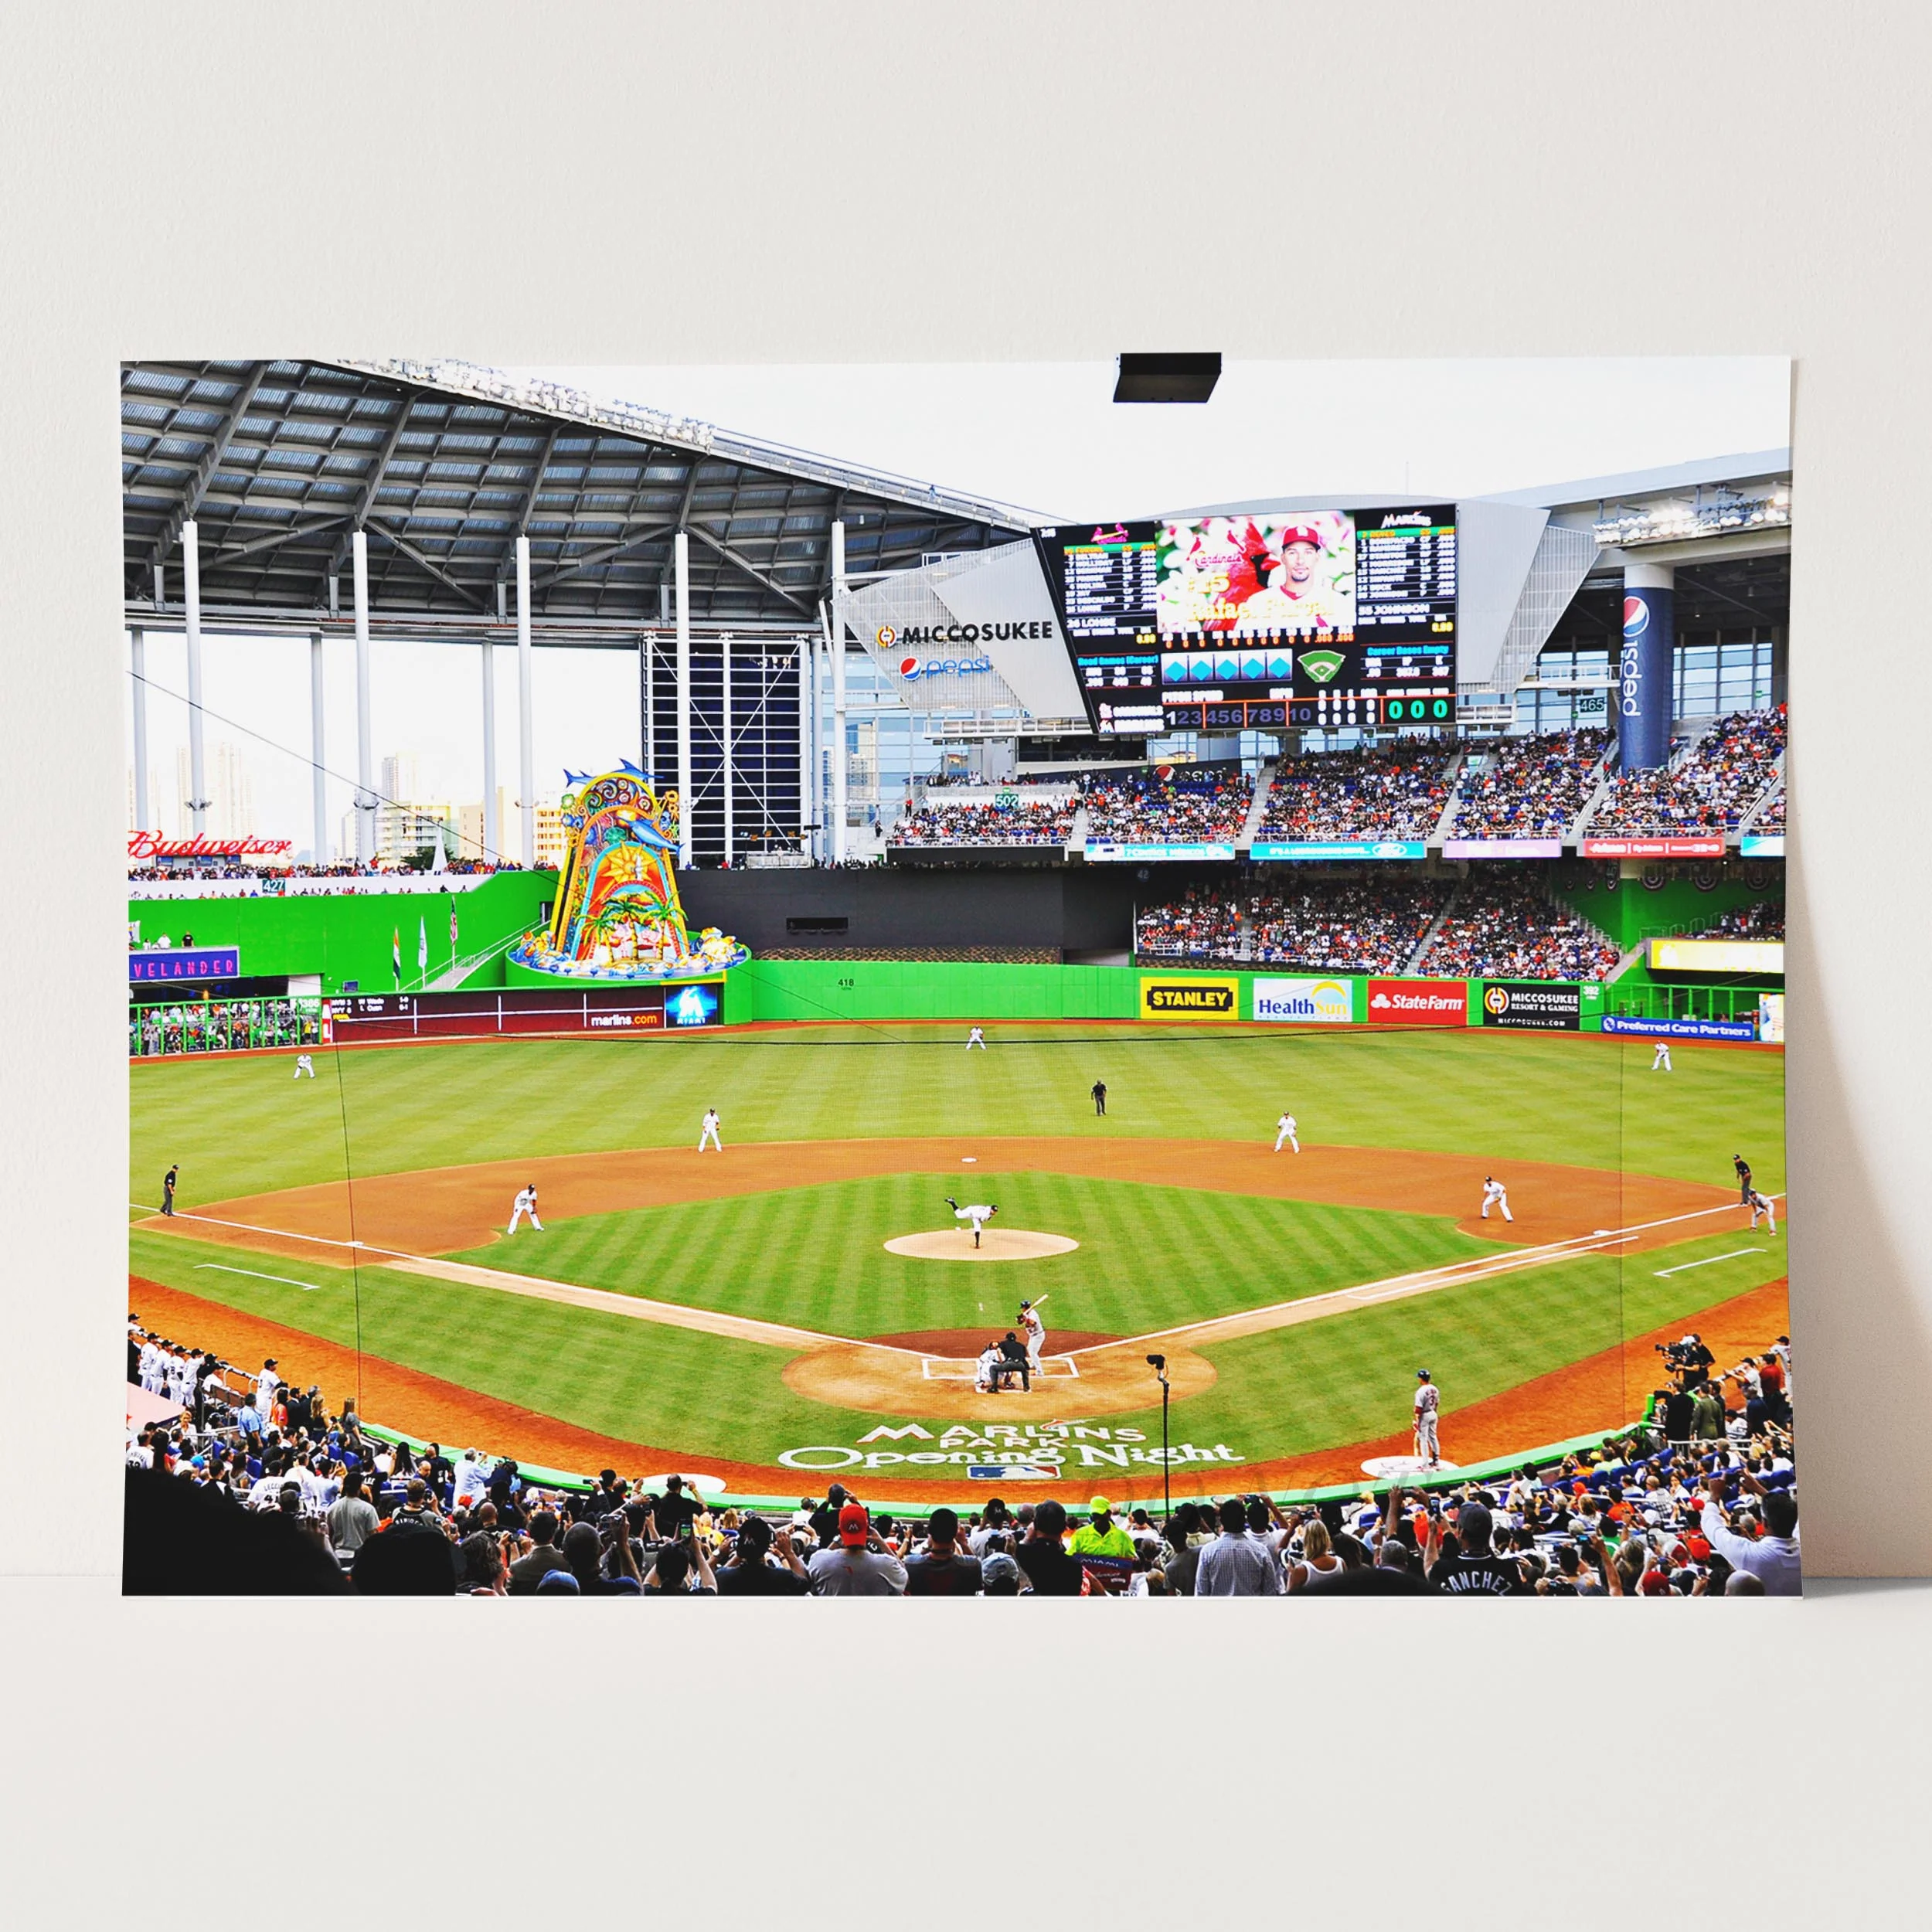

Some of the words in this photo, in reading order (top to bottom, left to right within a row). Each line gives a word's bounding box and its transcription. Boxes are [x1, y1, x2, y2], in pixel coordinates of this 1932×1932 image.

[1195, 551, 1245, 567] Cardinals
[903, 621, 1053, 644] MICCOSUKEE
[926, 655, 991, 679] pepsi
[1624, 640, 1642, 716] pepsi
[1389, 700, 1403, 719] 0
[1410, 700, 1425, 719] 0
[1434, 699, 1447, 718] 0
[1580, 699, 1604, 711] 465
[996, 795, 1019, 808] 502
[128, 830, 292, 859] Budweiser
[1138, 870, 1150, 879] 42
[263, 879, 284, 892] 427
[134, 960, 233, 978] VELANDER
[1152, 991, 1228, 1007] STANLEY
[1511, 993, 1578, 1004] MICCOSUKEE
[591, 1014, 657, 1026] marlins.com
[1617, 1021, 1670, 1032] Preferred
[1671, 1023, 1699, 1033] Care
[1699, 1025, 1751, 1036] Partners
[855, 1420, 1147, 1444] MARLINS
[939, 1437, 1069, 1448] PARK
[777, 1445, 1066, 1469] Opening
[1072, 1444, 1246, 1467] Night
